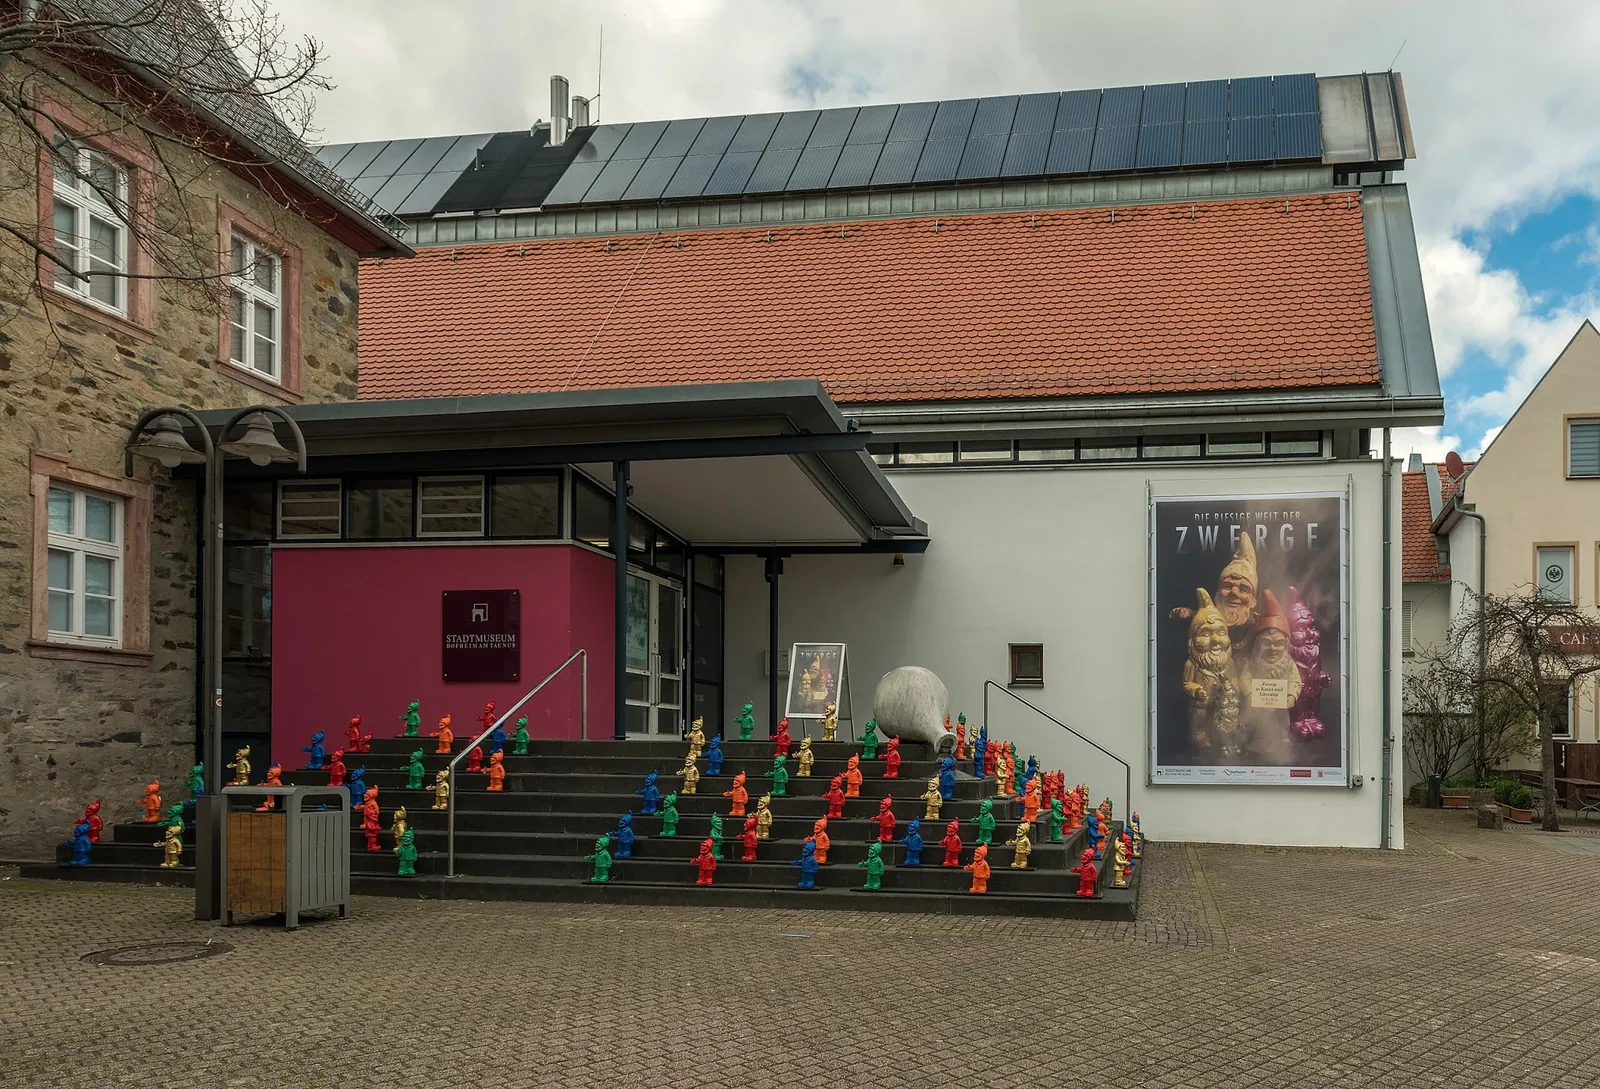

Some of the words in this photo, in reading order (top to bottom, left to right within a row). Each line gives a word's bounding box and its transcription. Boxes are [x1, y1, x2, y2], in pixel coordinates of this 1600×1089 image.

[1194, 513, 1210, 522] DIE
[1214, 512, 1251, 522] RIESIGE
[1255, 511, 1278, 521] WELT
[1283, 511, 1301, 520] DER
[1175, 522, 1318, 553] ZWERGE
[446, 634, 516, 643] STADTMUSEUM
